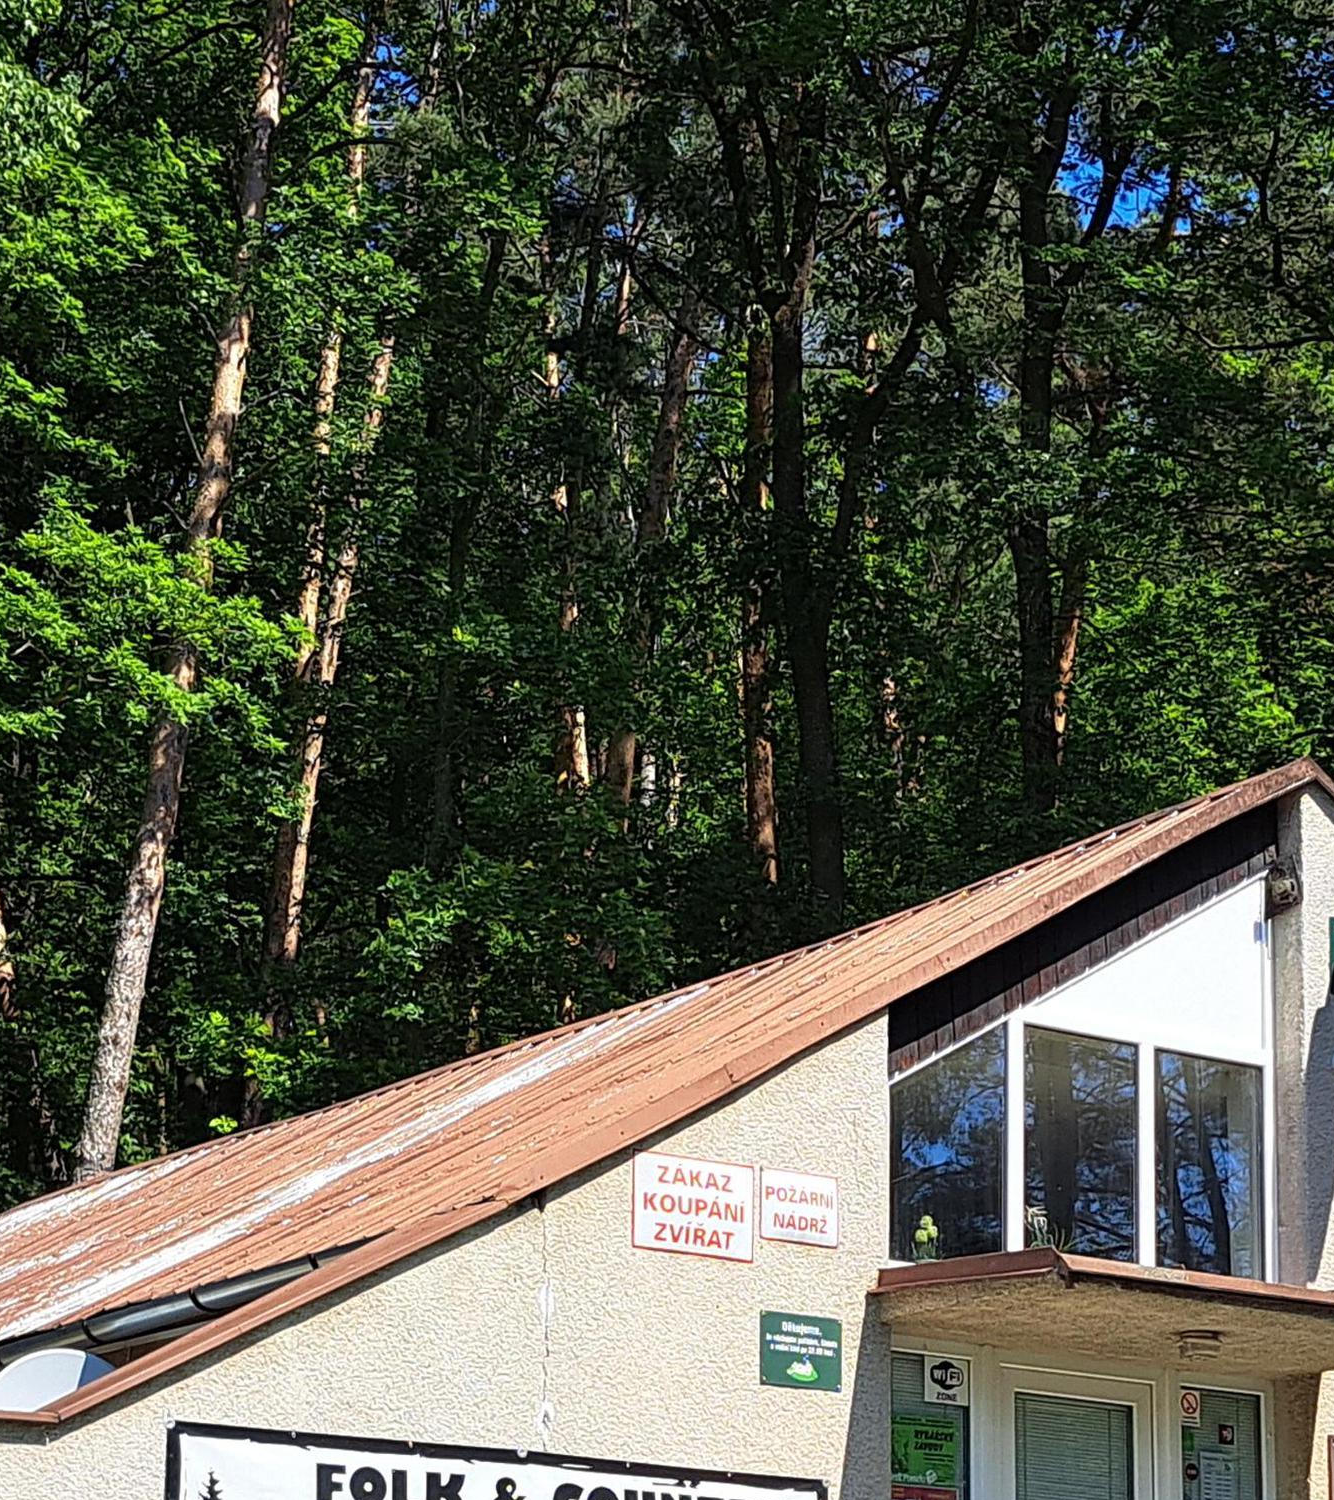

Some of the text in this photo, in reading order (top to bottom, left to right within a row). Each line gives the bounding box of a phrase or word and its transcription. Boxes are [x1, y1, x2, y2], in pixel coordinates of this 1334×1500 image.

[657, 1163, 734, 1193] ZÁKAZ
[643, 1191, 745, 1223] KOUPÁNÍ
[765, 1185, 833, 1210] POŽÁRNÍ
[654, 1221, 735, 1250] ZVÍŘAT
[773, 1210, 828, 1234] NÁDRŽ
